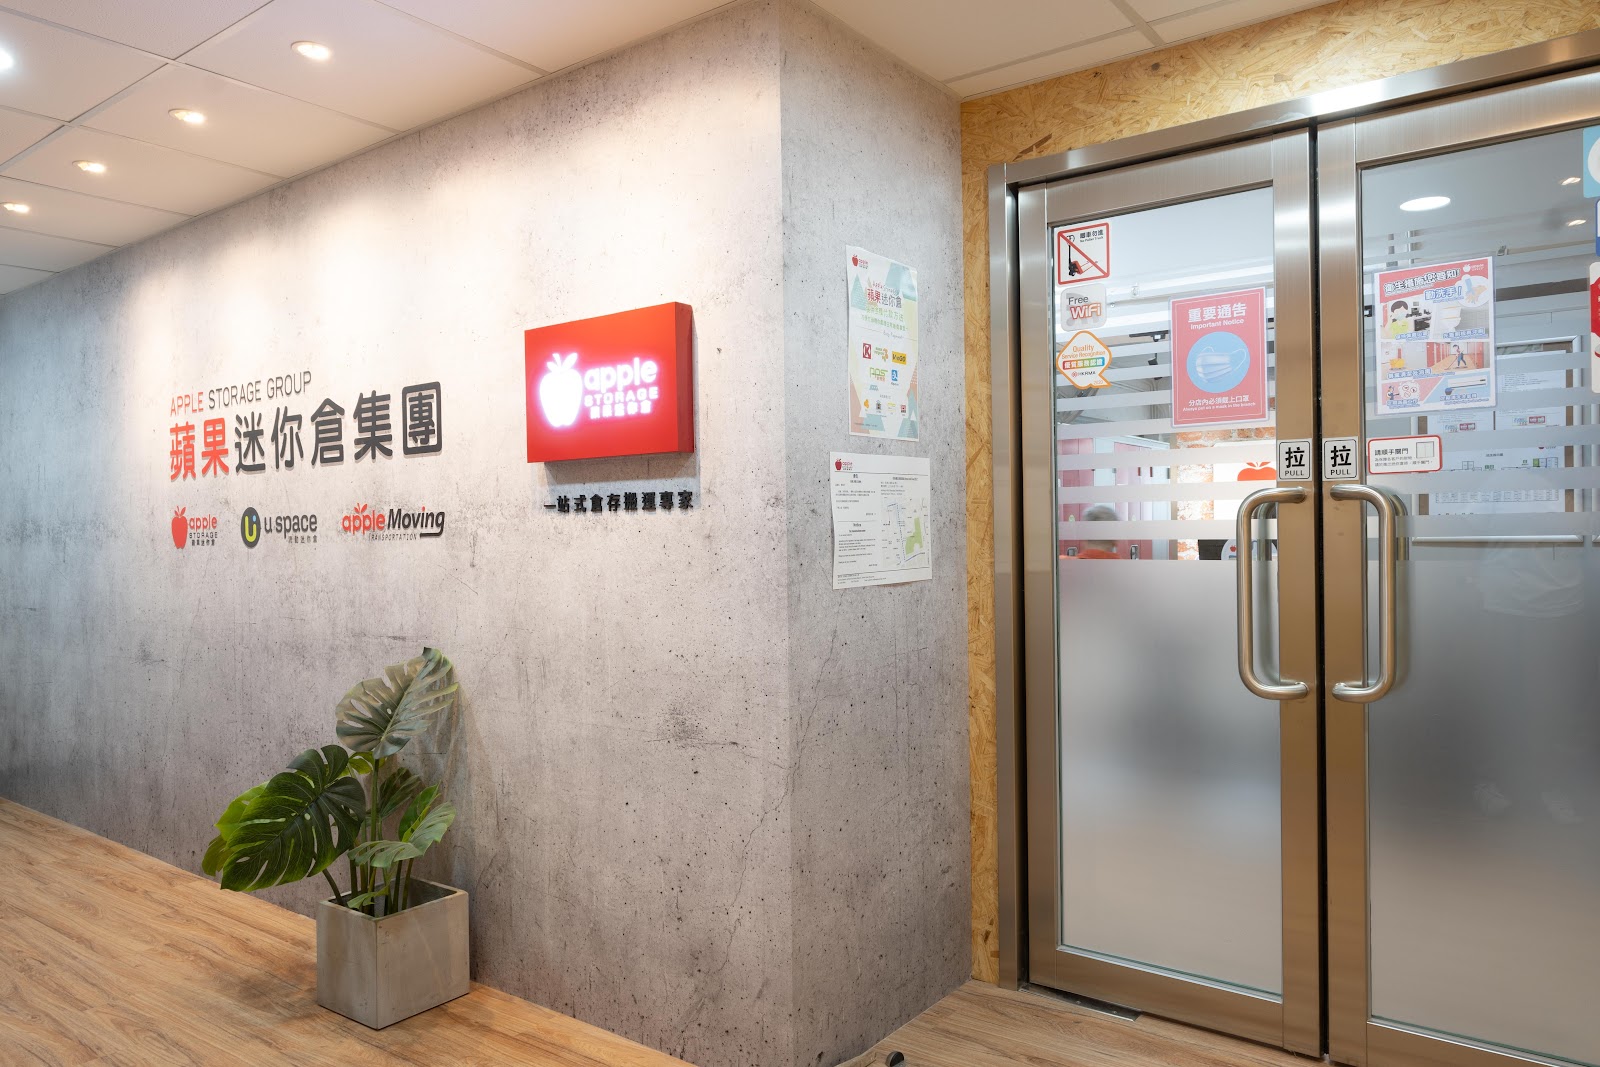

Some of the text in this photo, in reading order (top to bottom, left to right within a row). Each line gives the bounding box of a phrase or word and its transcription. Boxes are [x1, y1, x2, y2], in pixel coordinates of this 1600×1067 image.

[1068, 295, 1089, 306] Free
[1070, 303, 1102, 320] WiFi
[1188, 302, 1247, 322] 重要通告
[1190, 320, 1222, 330] Important
[1072, 344, 1094, 353] Quality
[584, 357, 658, 394] apple
[170, 370, 312, 417] APPLE STORAGE GROUP
[584, 387, 659, 406] STORAGE
[170, 381, 443, 481] 蘋果迷你倉集團
[1284, 446, 1305, 468] 拉
[1330, 445, 1352, 468] 拉
[188, 514, 218, 532] apple
[275, 514, 318, 538] space
[342, 506, 446, 538] apple Moving
[368, 532, 417, 541] TRANSPORTATION
